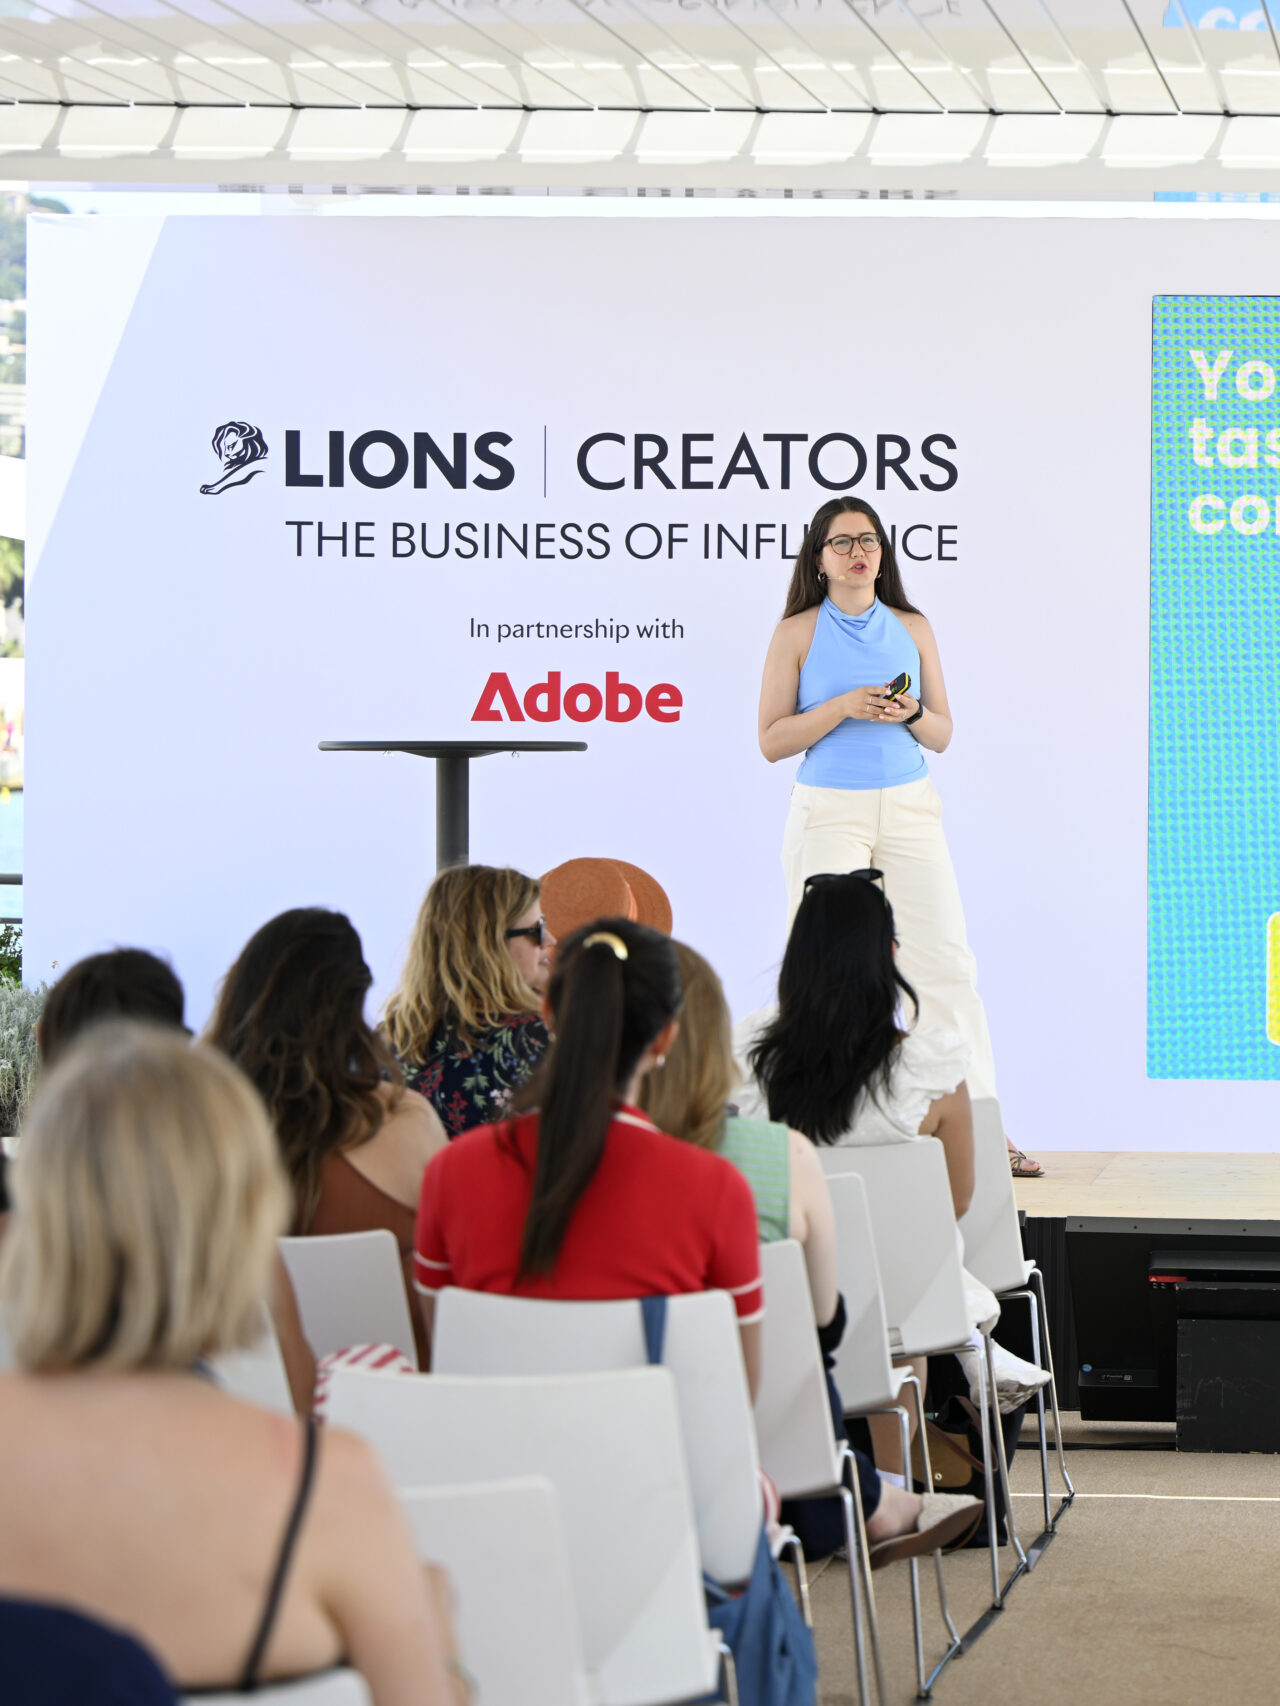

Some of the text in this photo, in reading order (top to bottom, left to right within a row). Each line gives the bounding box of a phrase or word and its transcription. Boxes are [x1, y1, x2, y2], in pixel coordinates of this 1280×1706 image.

[286, 430, 958, 491] LIONS CREATORS
[286, 521, 958, 561] THE BUSINESS OF INFLCE
[471, 618, 683, 643] In partnership with
[471, 671, 683, 723] Adobe
